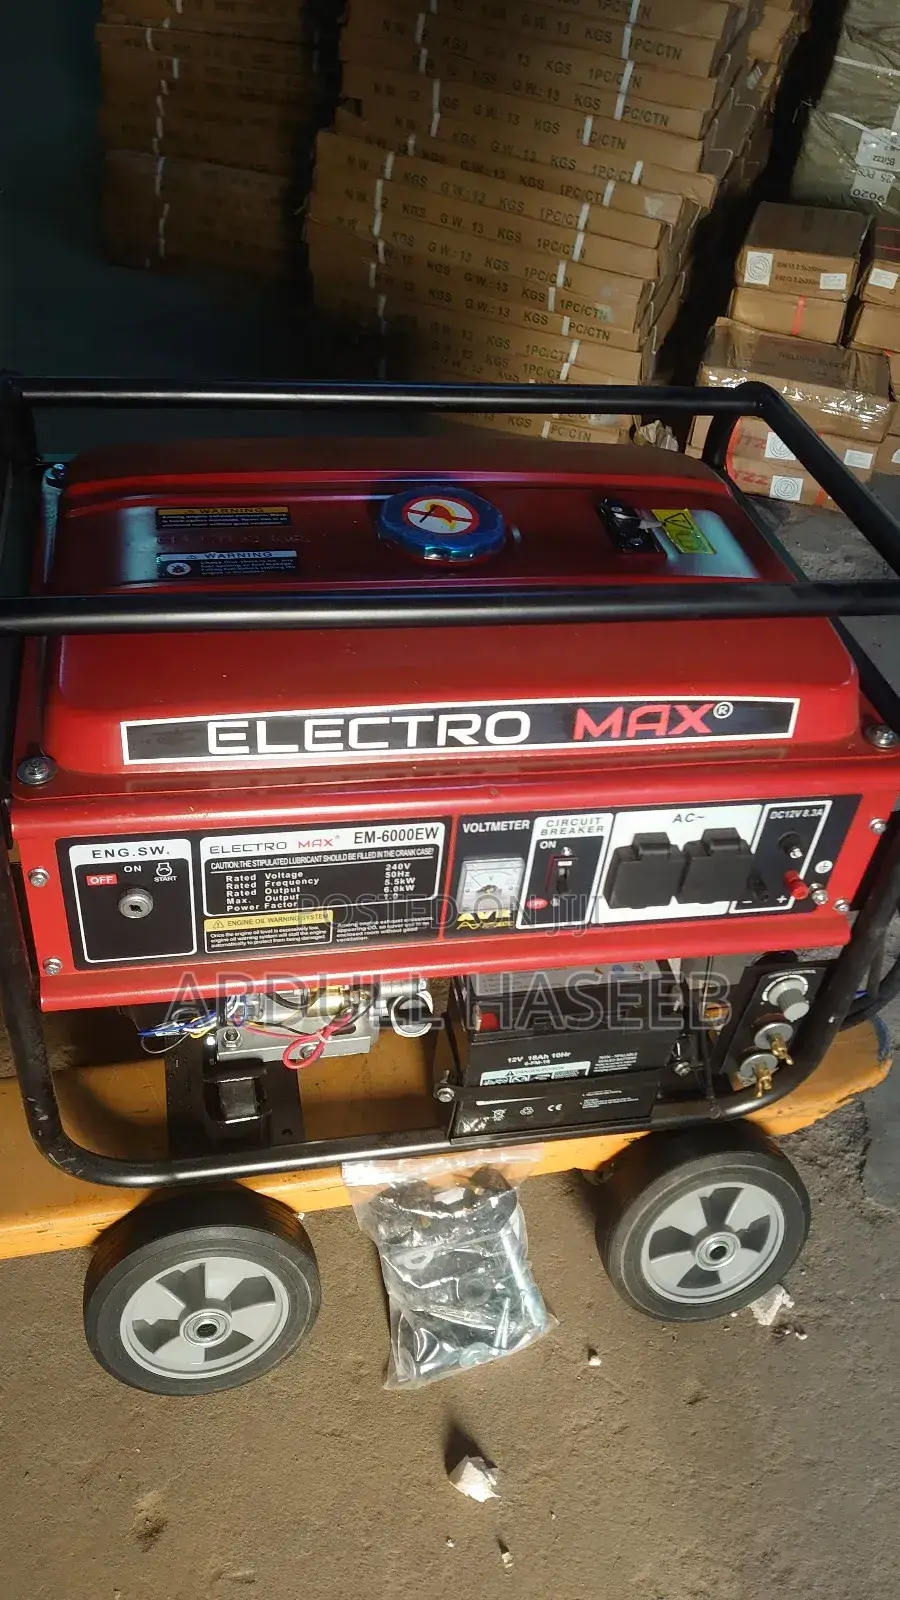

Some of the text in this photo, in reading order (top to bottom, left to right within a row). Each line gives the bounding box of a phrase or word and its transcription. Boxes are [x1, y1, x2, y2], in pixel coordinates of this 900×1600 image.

[584, 26, 613, 44] KGS
[545, 60, 572, 75] KGS
[588, 68, 642, 89] 1PC/CN
[574, 93, 601, 110] KGS
[622, 104, 669, 127] PC/CTN
[534, 118, 560, 134] KGS
[551, 155, 577, 171] KGS
[519, 174, 545, 190] KGS
[403, 171, 428, 188] KGS
[500, 196, 525, 213] KGS
[540, 207, 590, 230] 1PC/CT
[402, 203, 427, 219] KGS
[497, 228, 523, 244] KGS
[484, 256, 510, 273] KGS
[525, 266, 573, 289] 1PC/CN
[427, 260, 451, 276] KGS
[521, 287, 547, 303] KGS
[428, 288, 452, 303] KGS
[523, 311, 549, 326] KGS
[568, 321, 611, 341] PC/CTN
[486, 334, 511, 350] KGS
[484, 353, 509, 369] KGS
[507, 414, 532, 429] KGS
[204, 551, 273, 559] WARNING
[207, 710, 531, 755] ELECTRO
[463, 819, 530, 833] VOLTMETER
[541, 825, 604, 836] BREAKER
[546, 817, 603, 828] CIRCUIT
[209, 841, 287, 854] ELECTRO
[354, 826, 440, 845] EM-6000EW
[539, 840, 556, 849] ON
[92, 845, 170, 859] ENG.SW.
[252, 857, 288, 868] STIPULATED
[289, 855, 323, 865] LUBRICANT
[323, 853, 347, 863] SHOULD
[347, 852, 356, 861] BE
[356, 850, 376, 860] FILLED
[383, 849, 395, 858] THE
[395, 848, 416, 857] CRANK
[123, 865, 142, 873] ON
[225, 862, 411, 882] Rated Voltage 240V
[89, 876, 114, 885] OFF
[226, 882, 257, 890] Rated
[264, 878, 320, 888] Frequency
[226, 877, 416, 897] Rated Output 5.5kW
[264, 894, 300, 903] Output
[383, 884, 415, 893] 6.0kW
[226, 892, 398, 912] Power Factor 1.0
[227, 912, 328, 927] ENGINE OIL WARNING SYSTEM
